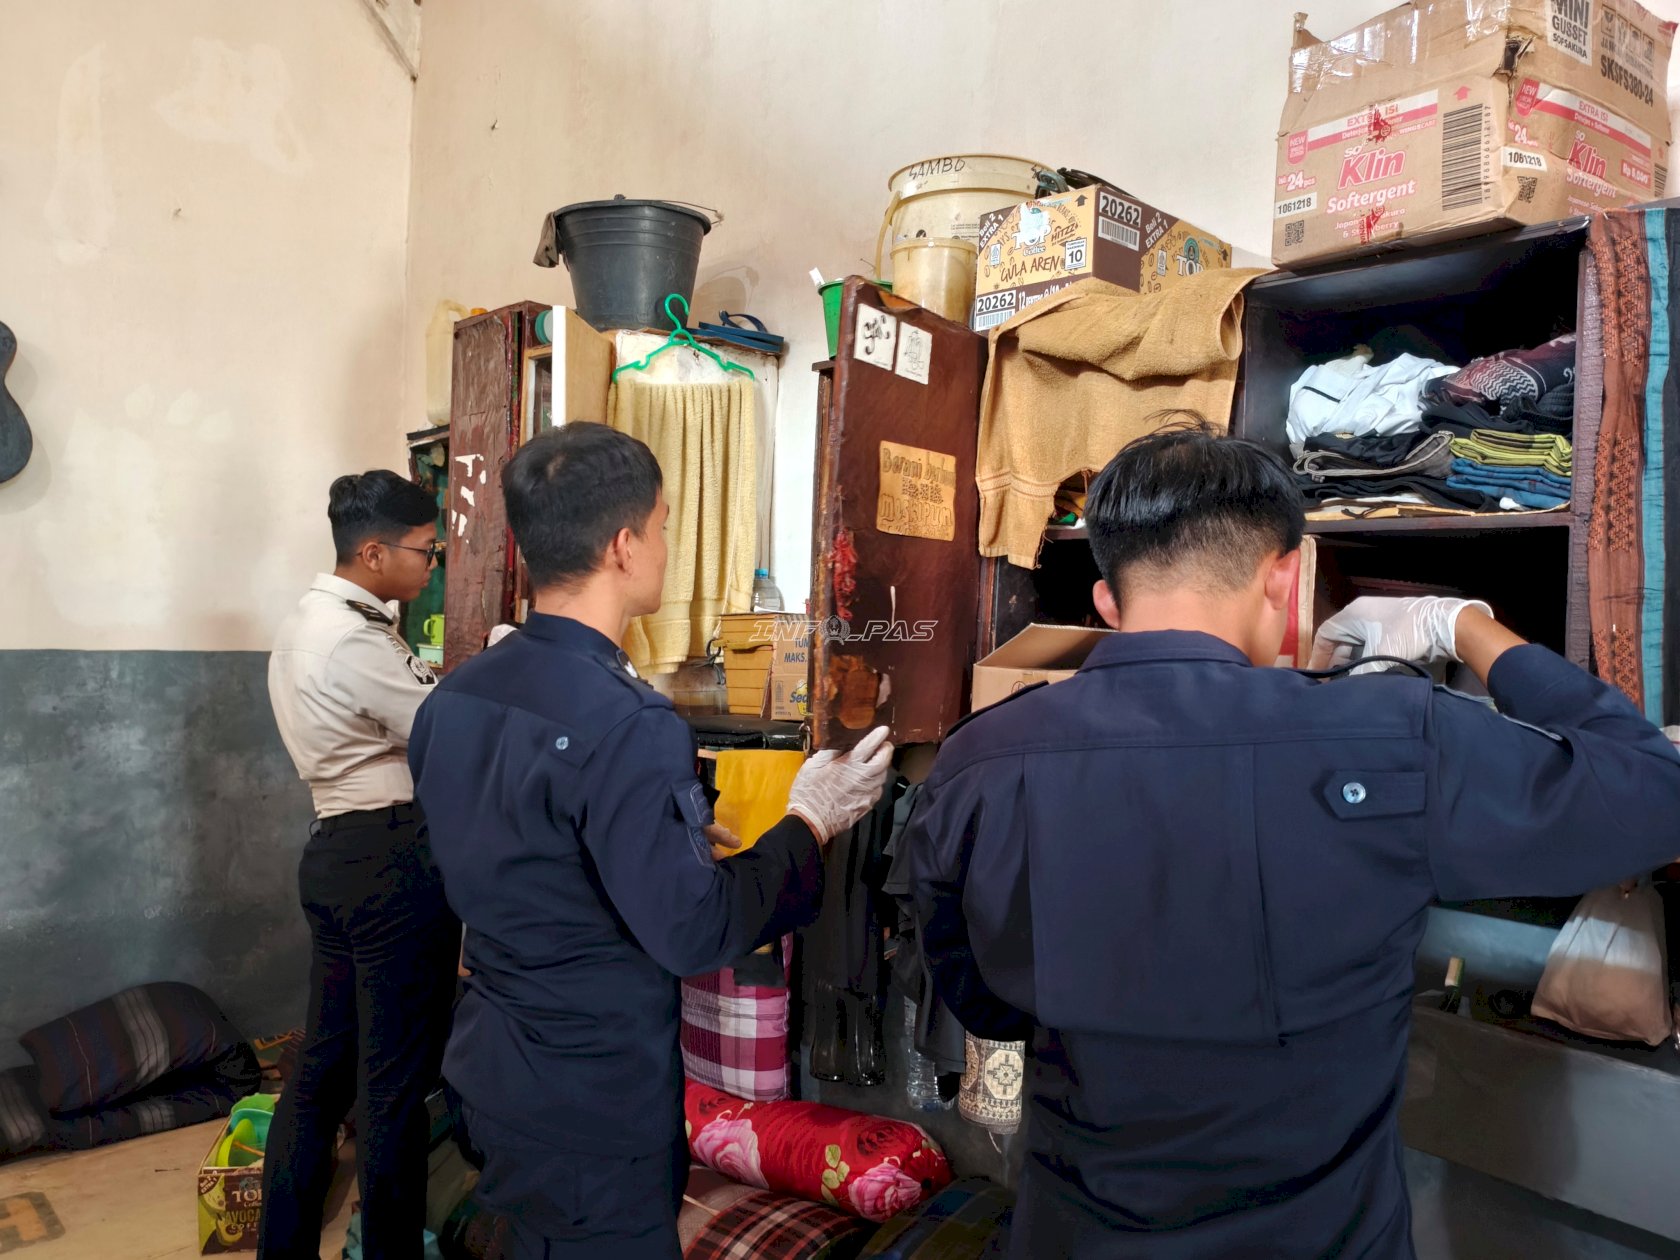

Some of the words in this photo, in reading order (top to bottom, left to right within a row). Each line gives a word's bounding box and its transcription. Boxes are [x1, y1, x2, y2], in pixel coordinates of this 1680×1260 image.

[1552, 15, 1588, 46] GUSSET
[1552, 33, 1588, 59] SOFSAKURA
[1578, 101, 1599, 118] EXTRA
[1514, 122, 1528, 145] 24
[1338, 147, 1406, 190] Klin
[1508, 152, 1542, 167] 1061218
[1567, 140, 1607, 181] Klin
[1286, 171, 1304, 192] 24
[1566, 168, 1617, 198] Softergent
[1277, 197, 1312, 215] 1061218
[1327, 179, 1417, 214] Softergent
[1101, 195, 1140, 227] 20262
[1155, 211, 1162, 223] 2
[979, 223, 999, 248] EXTRA
[1145, 226, 1165, 249] EXTRA
[1068, 249, 1083, 264] 10
[1000, 262, 1027, 283] GULA
[1029, 255, 1061, 273] AREN
[977, 292, 1015, 313] 20262
